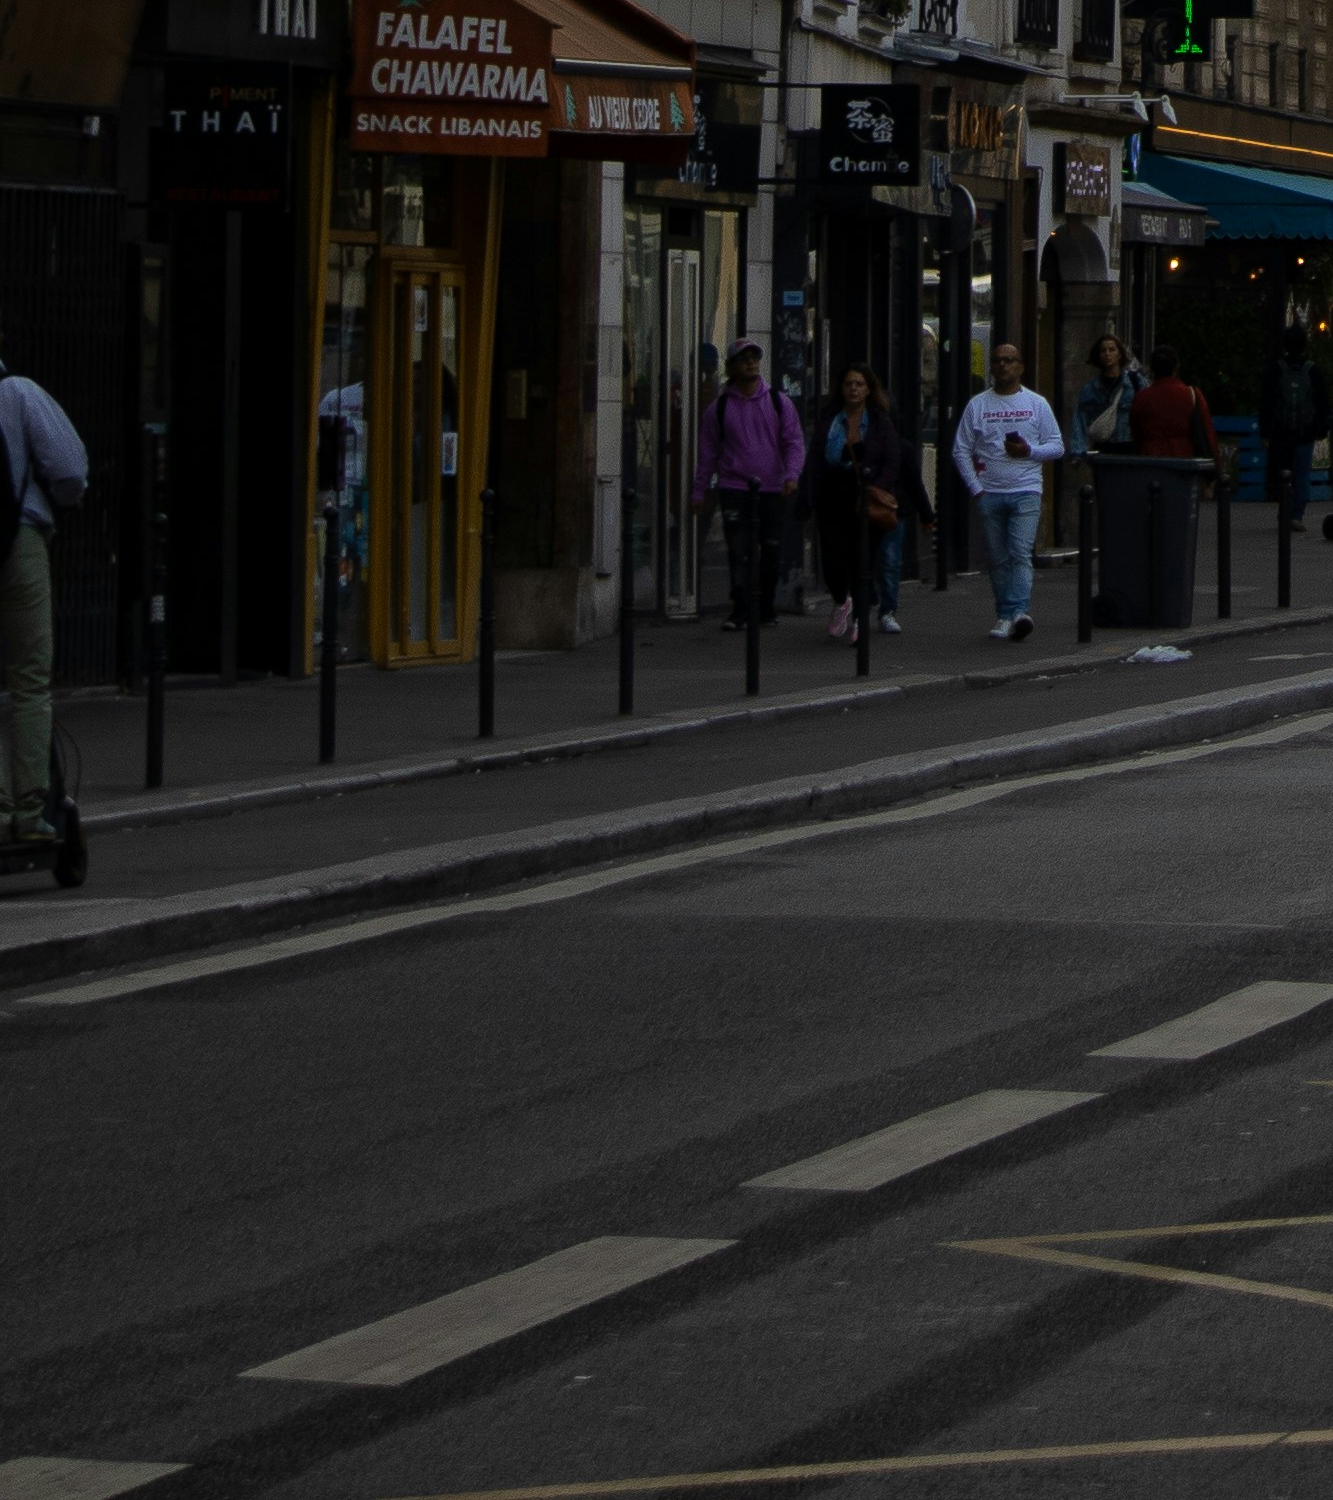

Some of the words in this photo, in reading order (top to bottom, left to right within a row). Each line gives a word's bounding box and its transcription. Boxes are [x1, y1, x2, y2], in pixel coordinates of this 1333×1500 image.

[376, 11, 513, 54] FALAFEL
[371, 58, 549, 104] CHAWARMA
[168, 104, 283, 134] THAÏ
[356, 113, 433, 135] SNACK
[439, 117, 543, 139] LIBANAIS
[588, 95, 602, 129] AU
[602, 96, 632, 129] VIEUX
